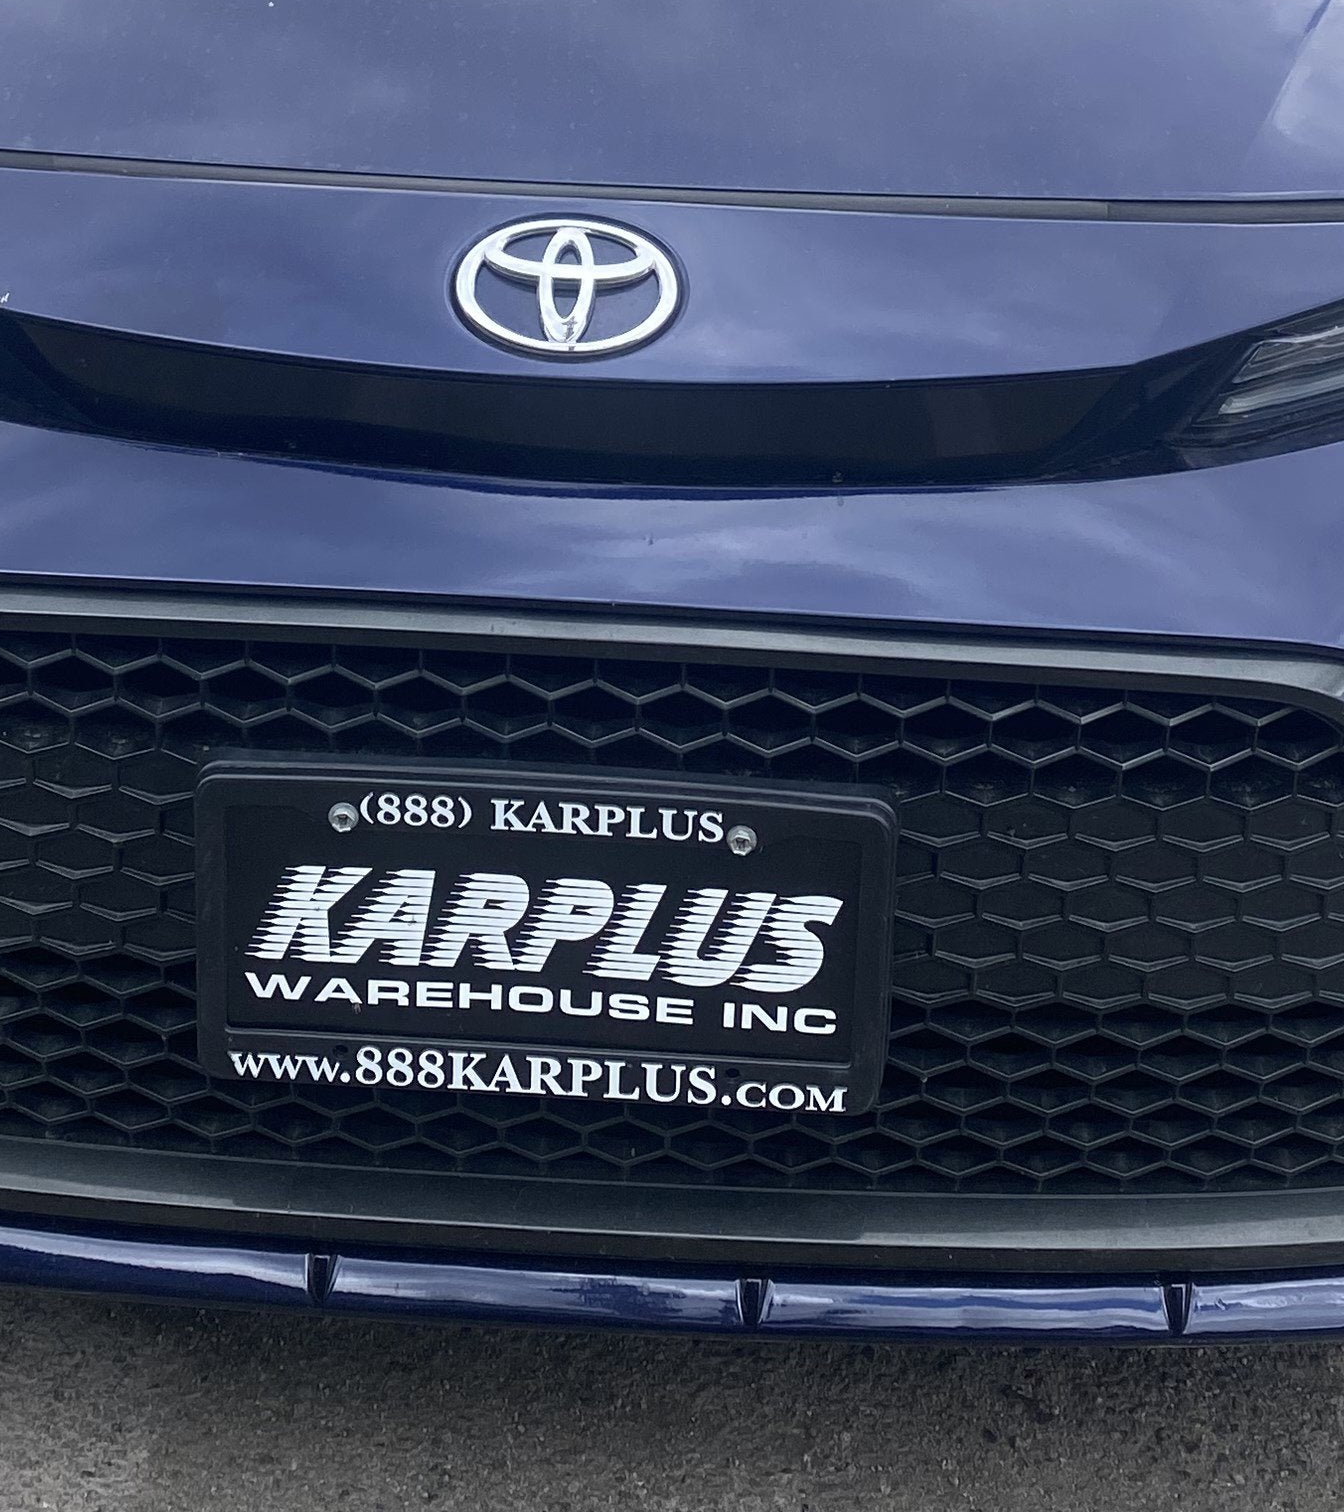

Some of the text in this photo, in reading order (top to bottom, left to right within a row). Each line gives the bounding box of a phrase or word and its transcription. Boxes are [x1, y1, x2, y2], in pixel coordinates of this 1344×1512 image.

[359, 791, 724, 844] (888) KARPLUS
[244, 865, 844, 993] KARPLUS
[244, 972, 838, 1035] WAREHOUSE INC
